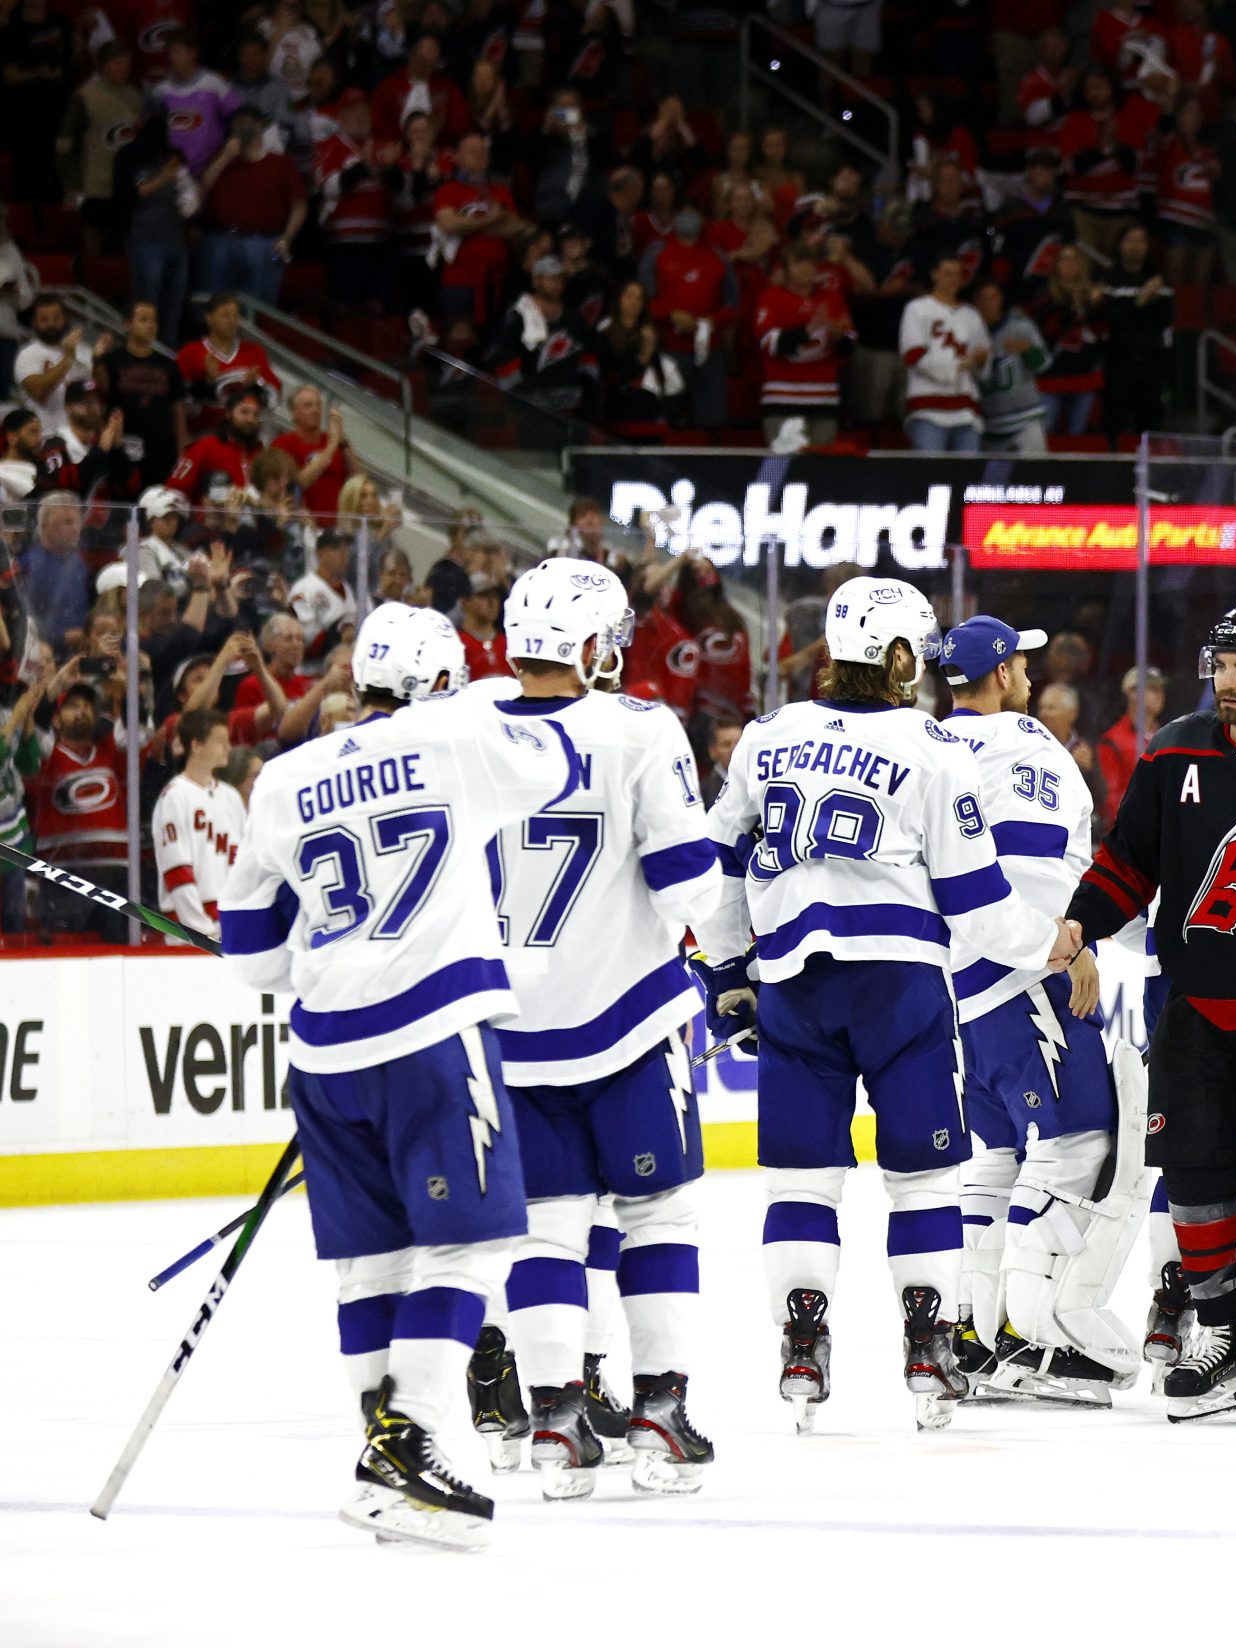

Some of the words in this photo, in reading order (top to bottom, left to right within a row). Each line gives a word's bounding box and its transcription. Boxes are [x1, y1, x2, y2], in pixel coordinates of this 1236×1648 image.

[610, 478, 952, 569] DieHard
[368, 642, 390, 661] 37
[525, 638, 543, 654] 17
[297, 754, 425, 823] GOURDE
[1012, 763, 1060, 812] 35
[1180, 763, 1201, 804] A
[748, 780, 885, 883] 98
[26, 859, 129, 911] CCM
[293, 804, 450, 951] 37
[138, 993, 293, 1115] veri
[164, 1271, 230, 1377] CCM
